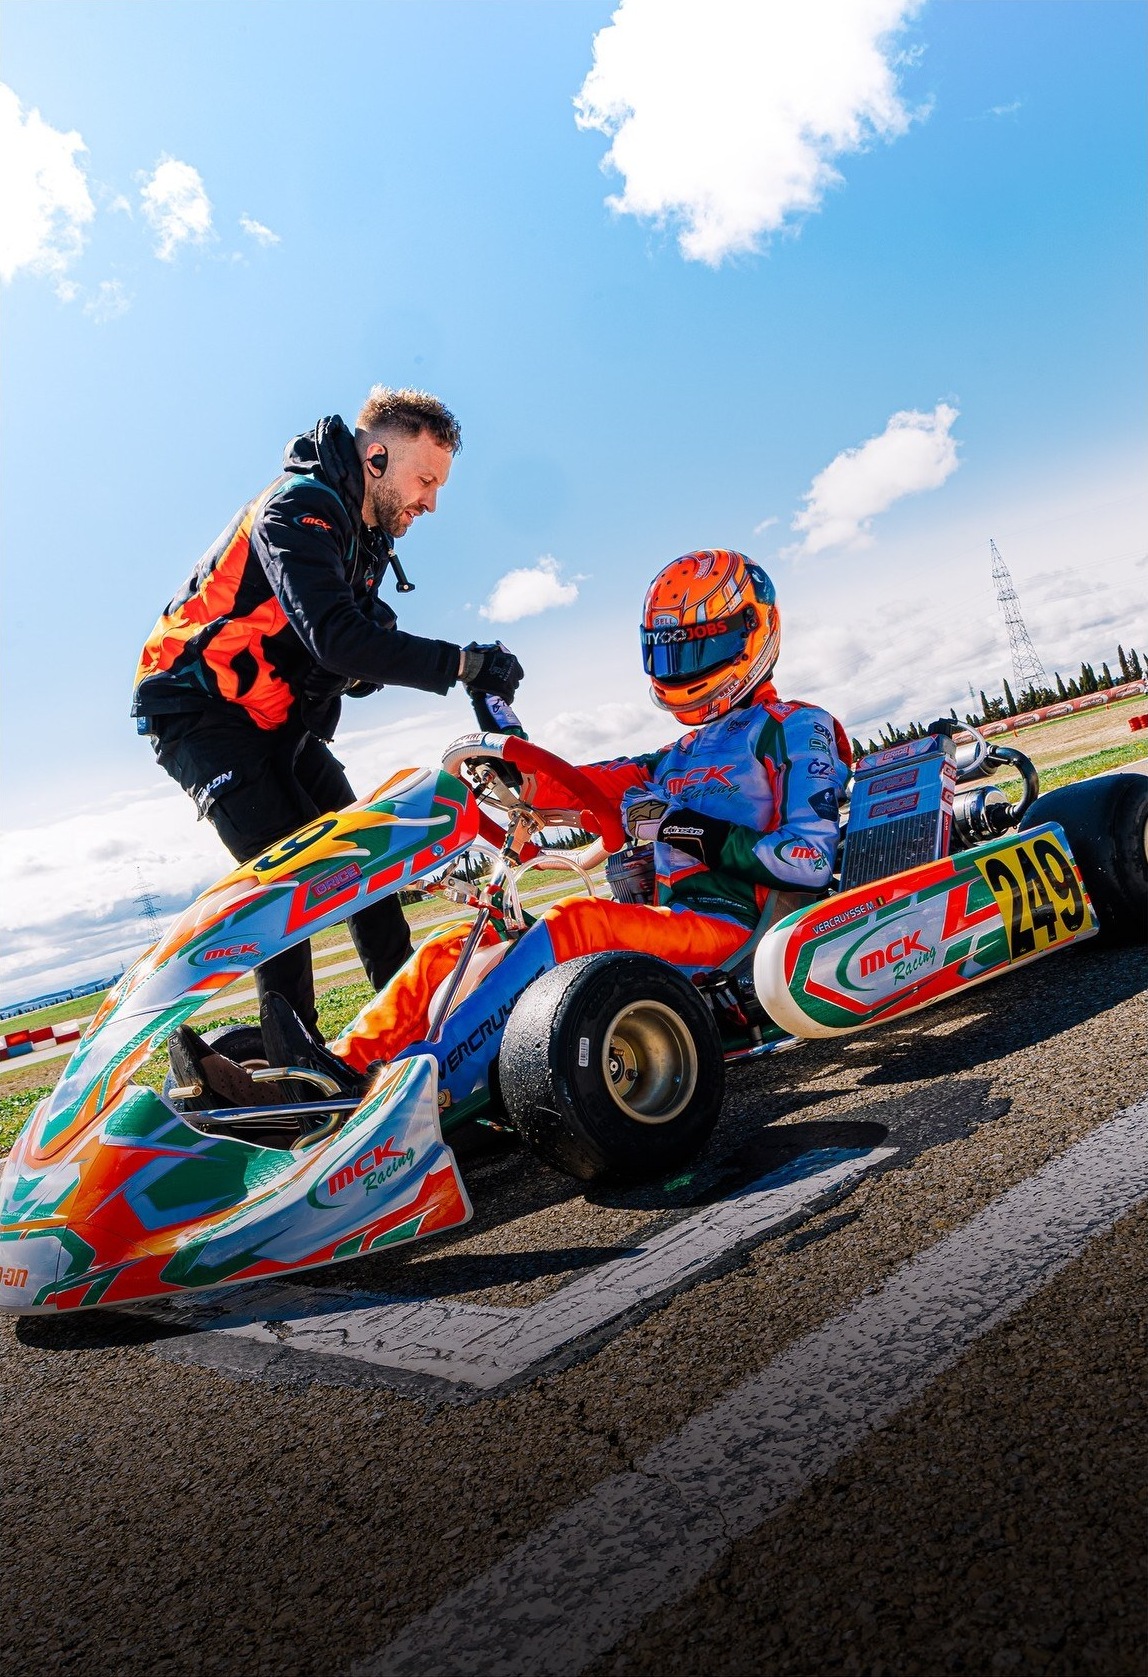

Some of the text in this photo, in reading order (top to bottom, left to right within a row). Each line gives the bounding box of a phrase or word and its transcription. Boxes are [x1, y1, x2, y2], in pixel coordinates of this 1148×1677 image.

[686, 620, 727, 641] JOBS
[985, 839, 1085, 961] 249
[812, 904, 867, 935] VERCRUYSSE
[227, 951, 267, 967] Racing
[893, 946, 937, 986] Racing
[363, 1146, 416, 1197] Racing
